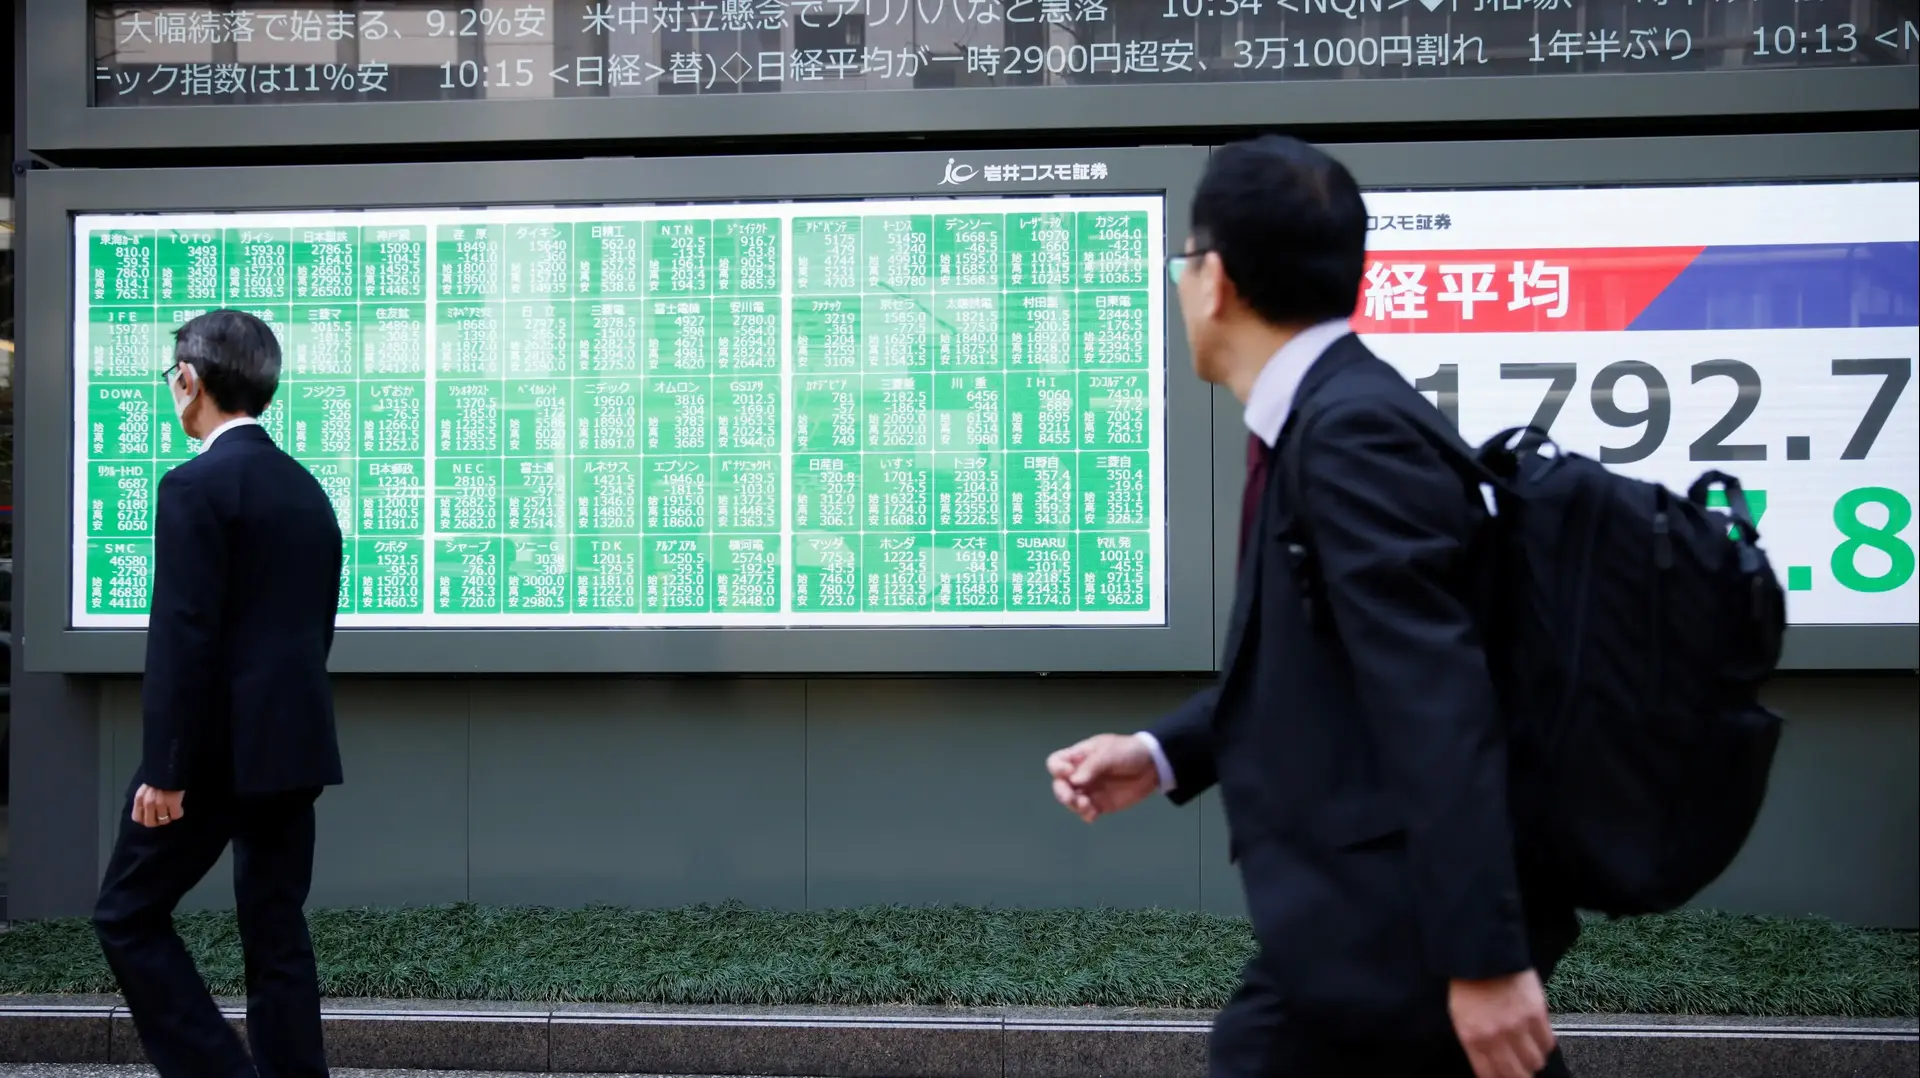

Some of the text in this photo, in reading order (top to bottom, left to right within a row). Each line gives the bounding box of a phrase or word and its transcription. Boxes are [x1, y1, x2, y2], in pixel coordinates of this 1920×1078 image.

[440, 59, 534, 89] 10:15
[1528, 28, 1692, 62] 1年半ぶり
[1753, 23, 1857, 55] 10:13
[984, 162, 1108, 182] 岩井コスモ証券
[944, 219, 994, 231] デンソー
[1094, 216, 1131, 228] カシオ
[661, 225, 693, 235] NTN
[1032, 229, 1070, 240] 10970
[1099, 229, 1141, 239] 1064.0
[169, 235, 210, 244] TOTO
[240, 232, 274, 244] ガイシ
[742, 235, 775, 246] 916.7
[826, 233, 855, 244] 5175
[889, 232, 926, 243] 51450
[956, 231, 998, 242] 1668.5
[380, 242, 419, 253] 1509.0
[458, 241, 497, 252] 1849.0
[530, 239, 567, 250] 15640
[603, 238, 636, 249] 562.0
[672, 237, 705, 248] 202.5
[1109, 240, 1141, 250] -42.0
[116, 246, 149, 257] 810.0
[188, 245, 217, 255] 3493
[245, 244, 284, 255] 1593.0
[312, 243, 352, 254] 2786.5
[674, 248, 705, 259] -13.5
[891, 243, 926, 254] -3240
[966, 245, 998, 255] -46.5
[247, 255, 284, 266] -103.0
[315, 254, 352, 265] -164.0
[382, 253, 419, 264] -104.5
[605, 250, 636, 261] -31.0
[118, 257, 149, 267] -59.5
[190, 256, 217, 267] -203
[1364, 260, 1571, 320] 経平均
[107, 311, 137, 321] JFE
[826, 312, 855, 323] 3219
[1028, 309, 1070, 320] 1901.5
[1100, 308, 1141, 319] 2344.0
[379, 319, 419, 330] 2489.0
[595, 316, 635, 327] 2378.5
[675, 315, 705, 326] 4927
[734, 314, 775, 325] 2780.0
[108, 321, 148, 332] 1597.0
[312, 320, 351, 331] 2015.5
[737, 325, 775, 336] -564.0
[828, 323, 855, 334] -361
[597, 327, 635, 338] -150.0
[678, 326, 705, 337] -598
[653, 381, 701, 393] オムロン
[1026, 377, 1056, 387] IHI
[301, 386, 347, 398] フジクラ
[583, 382, 631, 394] ニデック
[1040, 387, 1070, 398] 9060
[1107, 387, 1142, 398] 743.0
[101, 389, 142, 399] DOWA
[675, 394, 705, 405] 3816
[734, 393, 775, 404] 2012.5
[833, 391, 855, 402] 781
[885, 391, 926, 402] 2182.5
[968, 390, 998, 401] 6456
[119, 400, 148, 411] 4072
[322, 398, 351, 409] 3766
[379, 397, 418, 408] 1315.0
[457, 396, 497, 407] 1370.5
[536, 395, 566, 406] 6014
[595, 395, 635, 406] 1960.0
[970, 401, 998, 411] -944
[460, 407, 497, 418] -185.0
[597, 406, 635, 417] -221.0
[678, 404, 705, 415] -304
[736, 404, 775, 415] -169.0
[835, 402, 855, 413] -57
[121, 411, 148, 421] -266
[325, 409, 351, 420] -526
[454, 463, 485, 472] NEC
[583, 460, 631, 472] ルネサス
[652, 459, 701, 471] エプソン
[809, 458, 845, 470] 日産自
[951, 457, 988, 469] トヨタ
[1023, 456, 1060, 468] 日野自
[1095, 456, 1131, 468] 三菱自
[455, 475, 495, 485] 2810.5
[594, 473, 635, 484] 1421.5
[664, 472, 705, 483] 1946.0
[734, 472, 774, 483] 1439.5
[822, 471, 855, 482] 320.8
[885, 470, 926, 481] 1701.5
[956, 470, 999, 481] 2303.5
[1036, 469, 1070, 480] 357.4
[1108, 469, 1142, 480] 350.4
[118, 477, 147, 488] 6687
[379, 475, 418, 486] 1234.0
[1110, 480, 1142, 491] -19.6
[597, 484, 635, 495] -234.5
[895, 481, 926, 492] -76.5
[959, 481, 999, 492] -104.0
[120, 488, 147, 499] -743
[105, 543, 136, 552] SMC
[445, 539, 492, 551] シャープ
[591, 540, 622, 549] TDK
[808, 538, 845, 550] マツダ
[879, 538, 916, 550] ホンダ
[951, 538, 988, 550] スズキ
[1017, 538, 1066, 548] SUBARU
[111, 555, 147, 565] 46580
[378, 554, 417, 564] 1521.5
[462, 553, 495, 564] 726.3
[594, 553, 635, 563] 1201.5
[664, 552, 705, 563] 1250.5
[734, 552, 774, 562] 2574.0
[821, 551, 855, 561] 775.3
[885, 551, 926, 562] 1222.5
[956, 550, 999, 561] 1619.0
[1029, 550, 1071, 561] 2316.0
[1100, 549, 1142, 560] 1001.0
[113, 566, 147, 576] -2750
[388, 564, 417, 575] -95.0
[464, 564, 495, 575] -76.0
[596, 564, 635, 575] -129.5
[674, 563, 705, 574] -59.5
[736, 563, 774, 573] -192.5
[895, 562, 926, 572] -34.5
[1031, 561, 1071, 572] -101.5
[1111, 560, 1142, 571] -45.5
